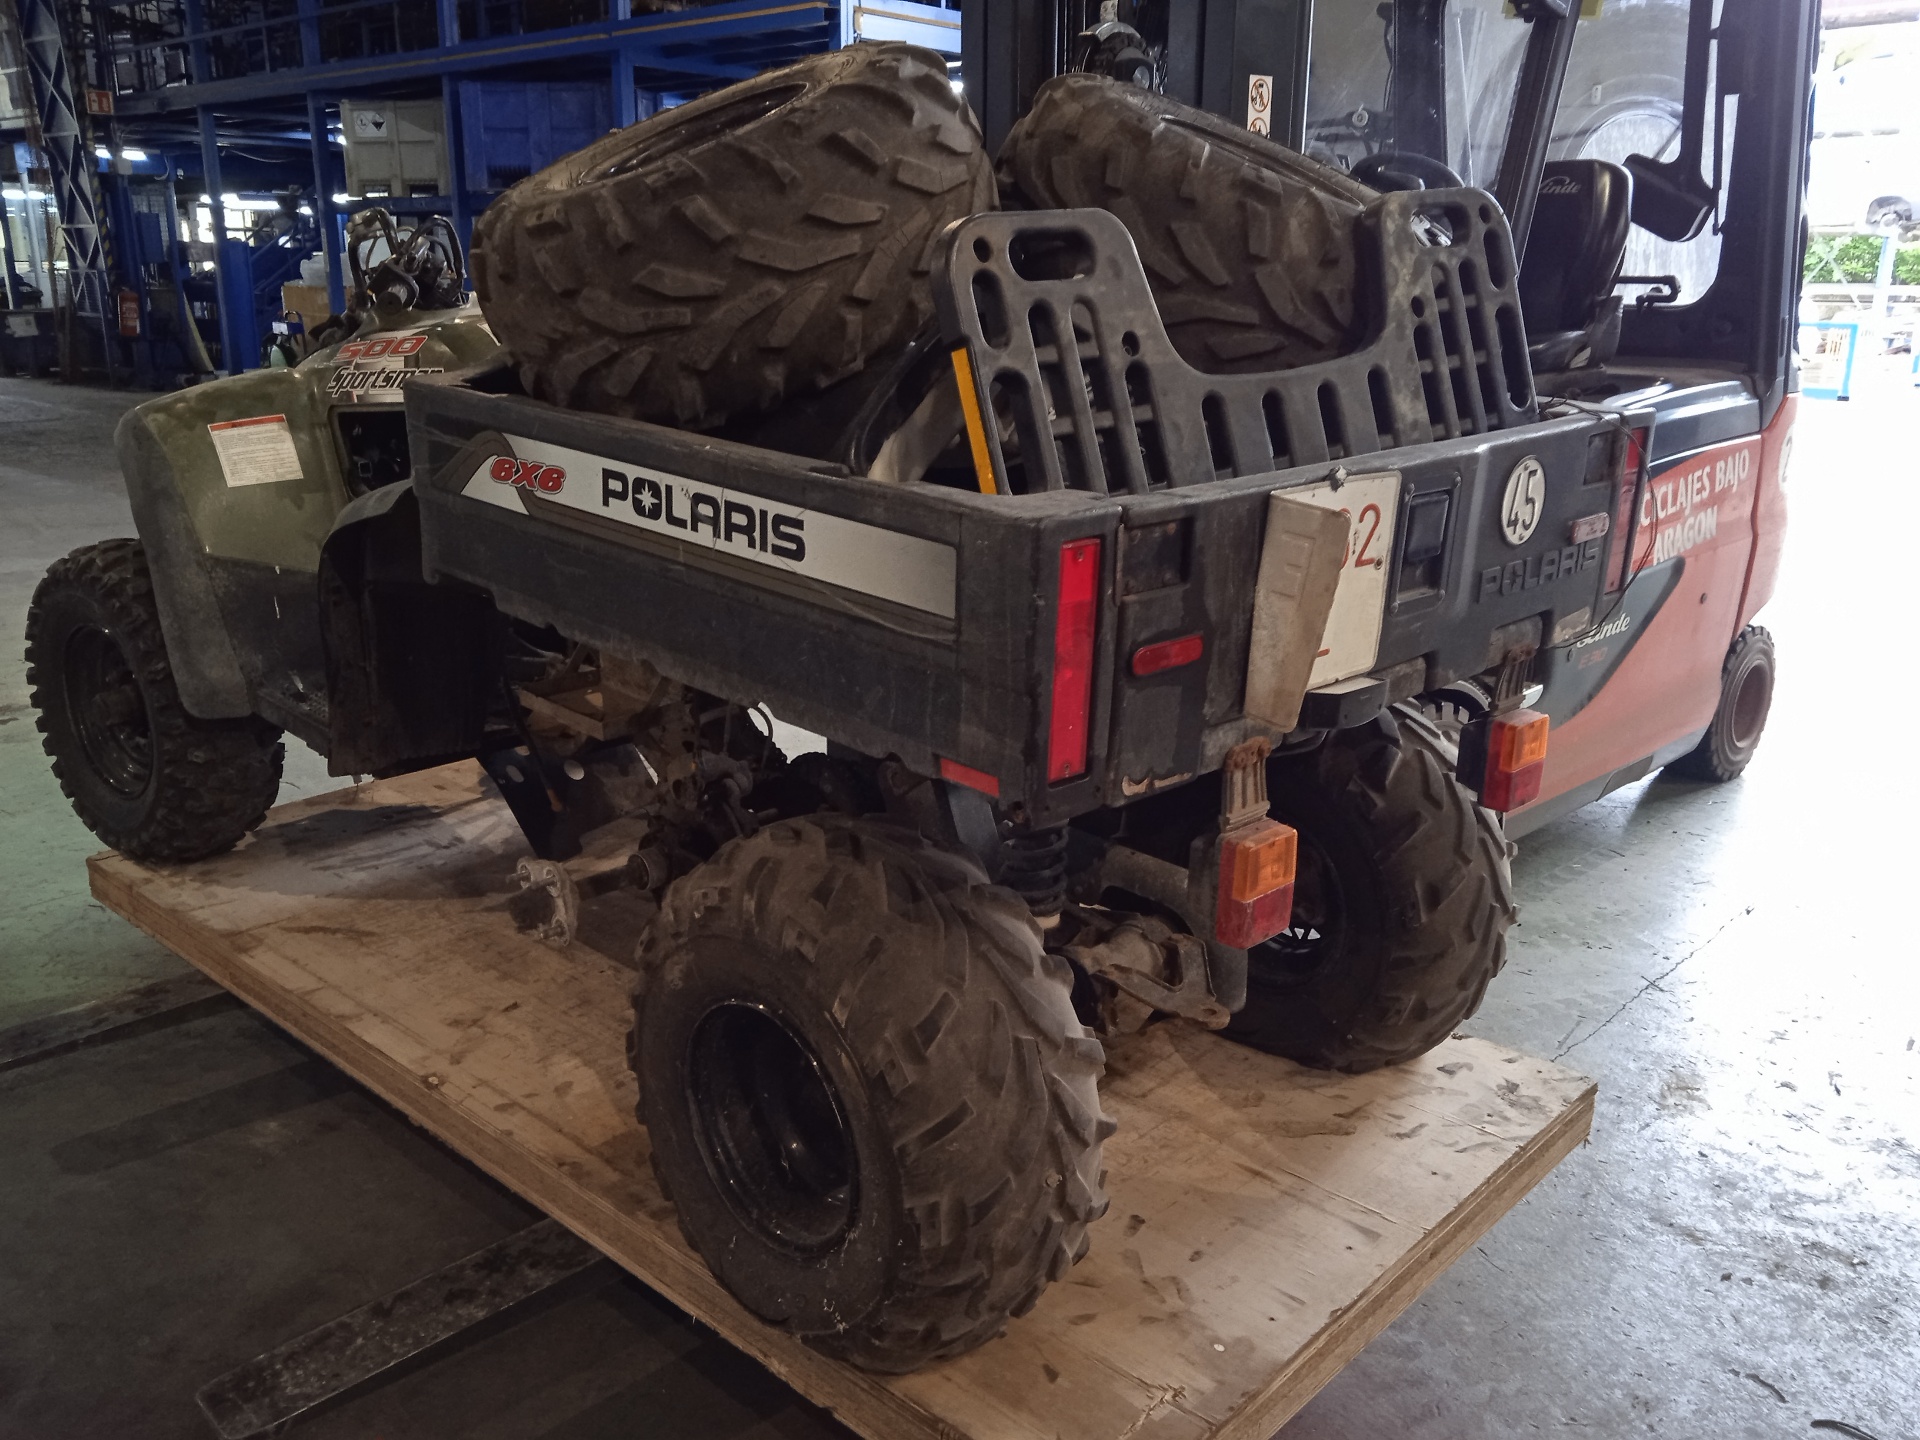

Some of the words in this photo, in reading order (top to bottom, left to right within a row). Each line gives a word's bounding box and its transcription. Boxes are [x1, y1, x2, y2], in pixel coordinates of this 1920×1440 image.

[331, 336, 428, 362] 500
[1506, 468, 1539, 535] 45
[1715, 449, 1750, 493] BAJO
[602, 467, 806, 562] POLARIS
[1653, 505, 1718, 566] ARAGON
[1477, 543, 1600, 604] POLARIS
